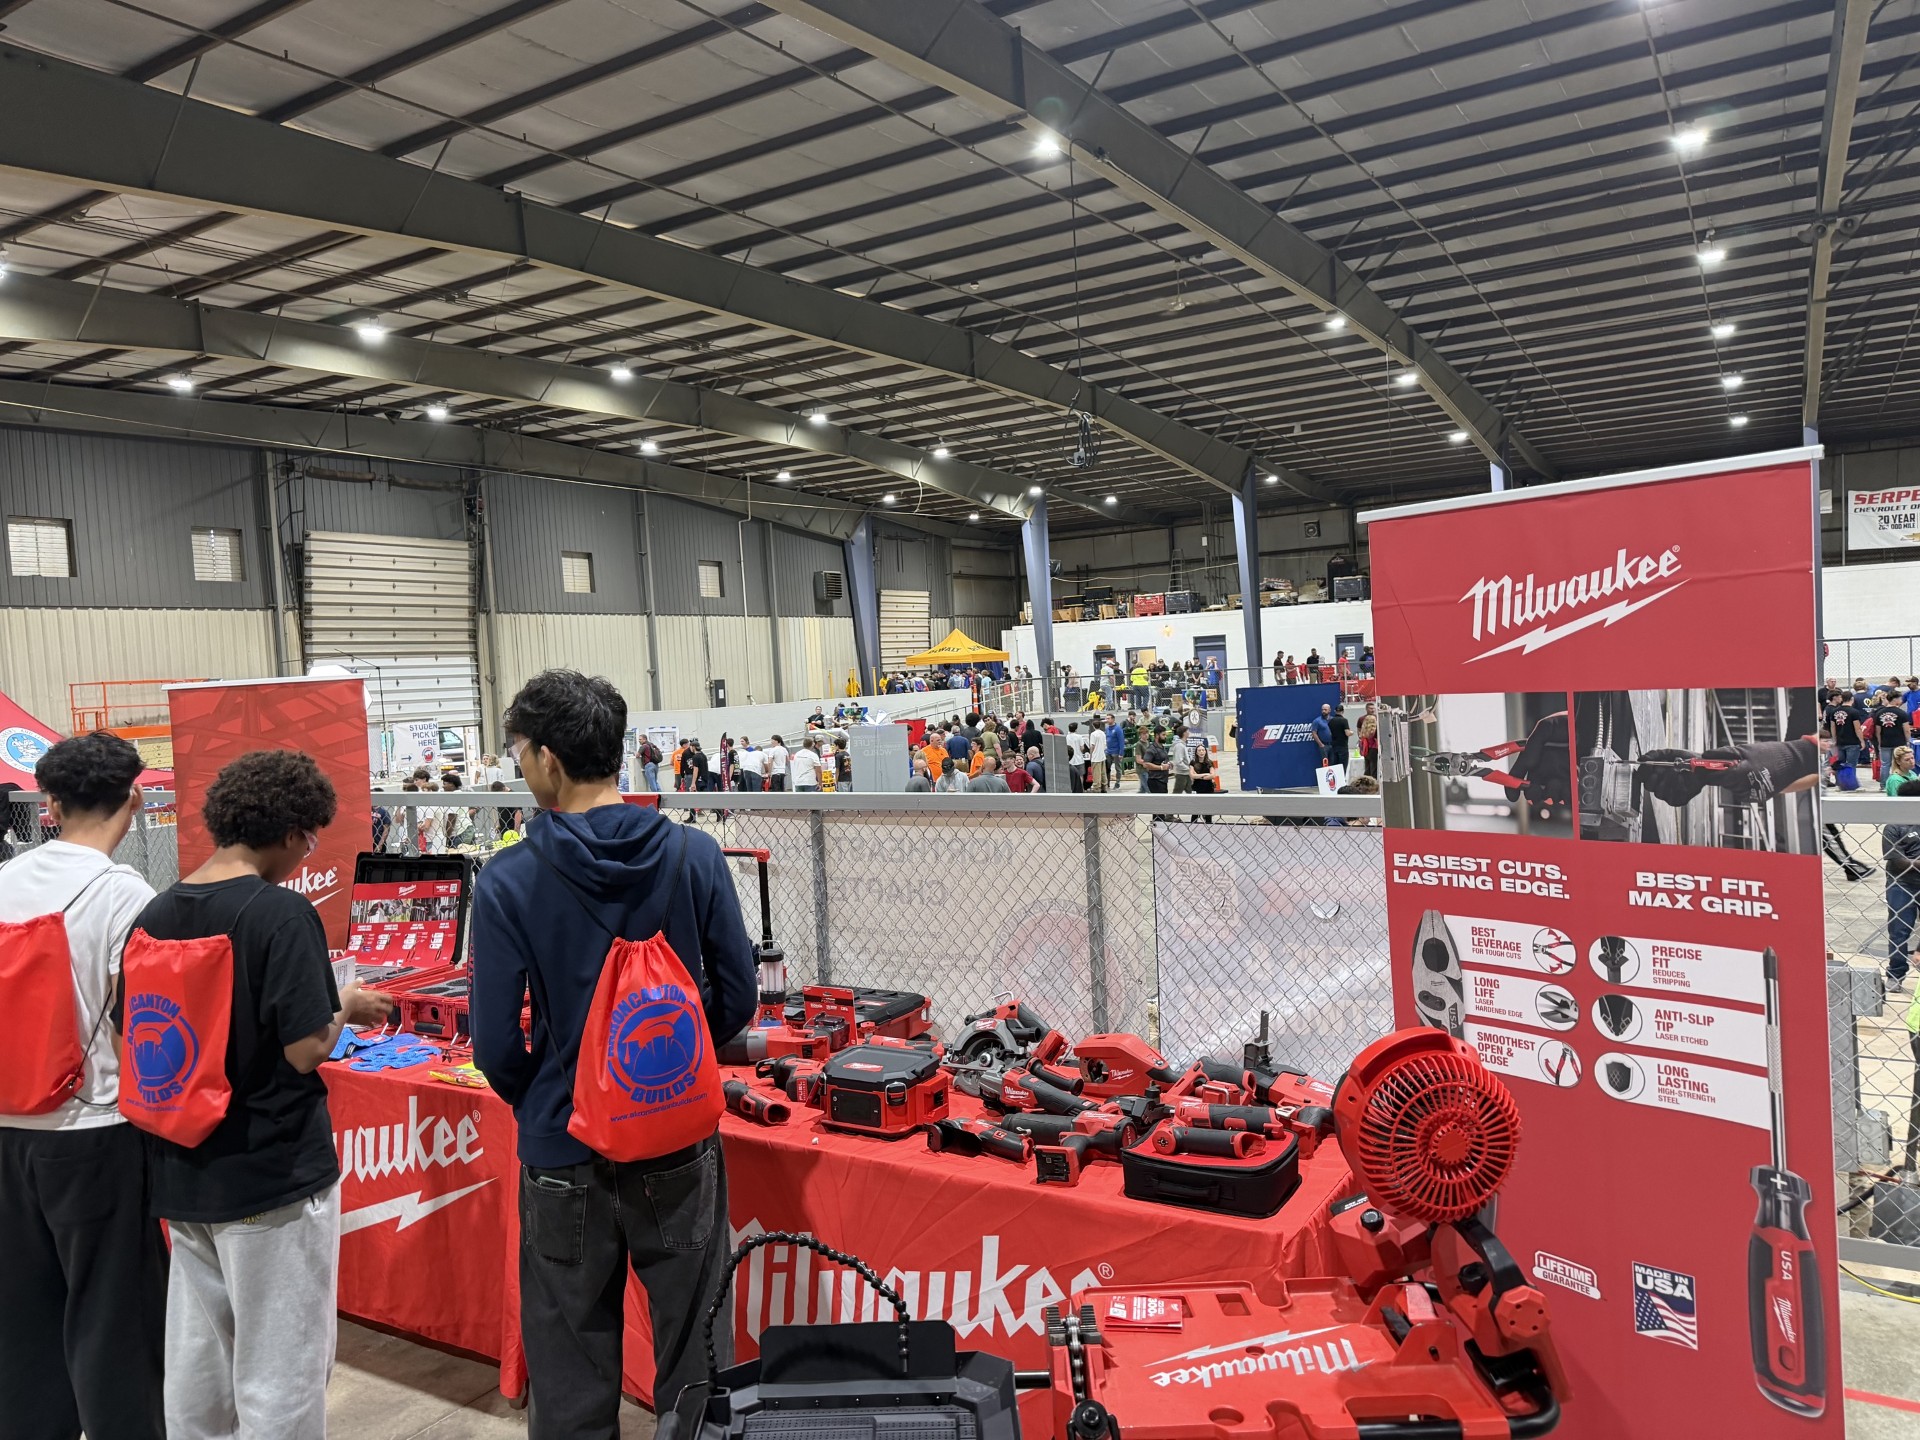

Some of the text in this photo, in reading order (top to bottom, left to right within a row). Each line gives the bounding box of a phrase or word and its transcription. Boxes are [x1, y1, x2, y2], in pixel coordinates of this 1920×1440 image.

[1854, 504, 1908, 513] CHEVROLET
[1892, 513, 1916, 523] YEAR
[1457, 548, 1682, 641] Milwaukee
[412, 731, 430, 739] PICK
[418, 739, 437, 747] HERE
[1393, 853, 1568, 881] EASIEST CUTS.
[1393, 870, 1494, 890] LASTING
[1500, 877, 1570, 899] EDGE.
[1636, 872, 1769, 898] BEST FIT.
[1629, 890, 1779, 920] MAX GRIP.
[1471, 926, 1496, 938] BEST
[1472, 938, 1522, 952] LEVERAGE
[1486, 949, 1504, 958] TOUGH
[1506, 952, 1522, 960] CUTS
[1652, 946, 1702, 961] PRECISE
[1652, 958, 1670, 969] FIT
[1652, 969, 1686, 979] REDUCES
[1474, 977, 1500, 989] LONG
[1652, 977, 1691, 988] STRIPPING
[1475, 987, 1495, 999] LIFE
[1475, 998, 1494, 1006] LASER
[1449, 1008, 1458, 1029] USA
[1476, 1005, 1523, 1018] HARDENED EDGE
[1654, 1009, 1714, 1027] ANTI-SLIP
[1655, 1020, 1674, 1032] TIP
[1477, 1031, 1535, 1051] SMOOTHEST
[1656, 1032, 1709, 1046] LASER ETCHED
[1478, 1043, 1514, 1058] OPEN &
[1479, 1052, 1509, 1067] CLOSE
[1657, 1063, 1689, 1078] LONG
[620, 1072, 697, 1105] BUILDS
[1657, 1075, 1709, 1094] LASTING
[1658, 1086, 1716, 1104] HIGH-STRENGTH
[1658, 1095, 1680, 1105] STEEL
[1539, 1256, 1592, 1285] LIFETIME
[1781, 1250, 1793, 1281] USA
[1542, 1270, 1590, 1295] GUARANTEE
[1634, 1265, 1689, 1286] MADE IN
[1635, 1274, 1693, 1300] USA
[1148, 1338, 1376, 1388] Milwaukee
